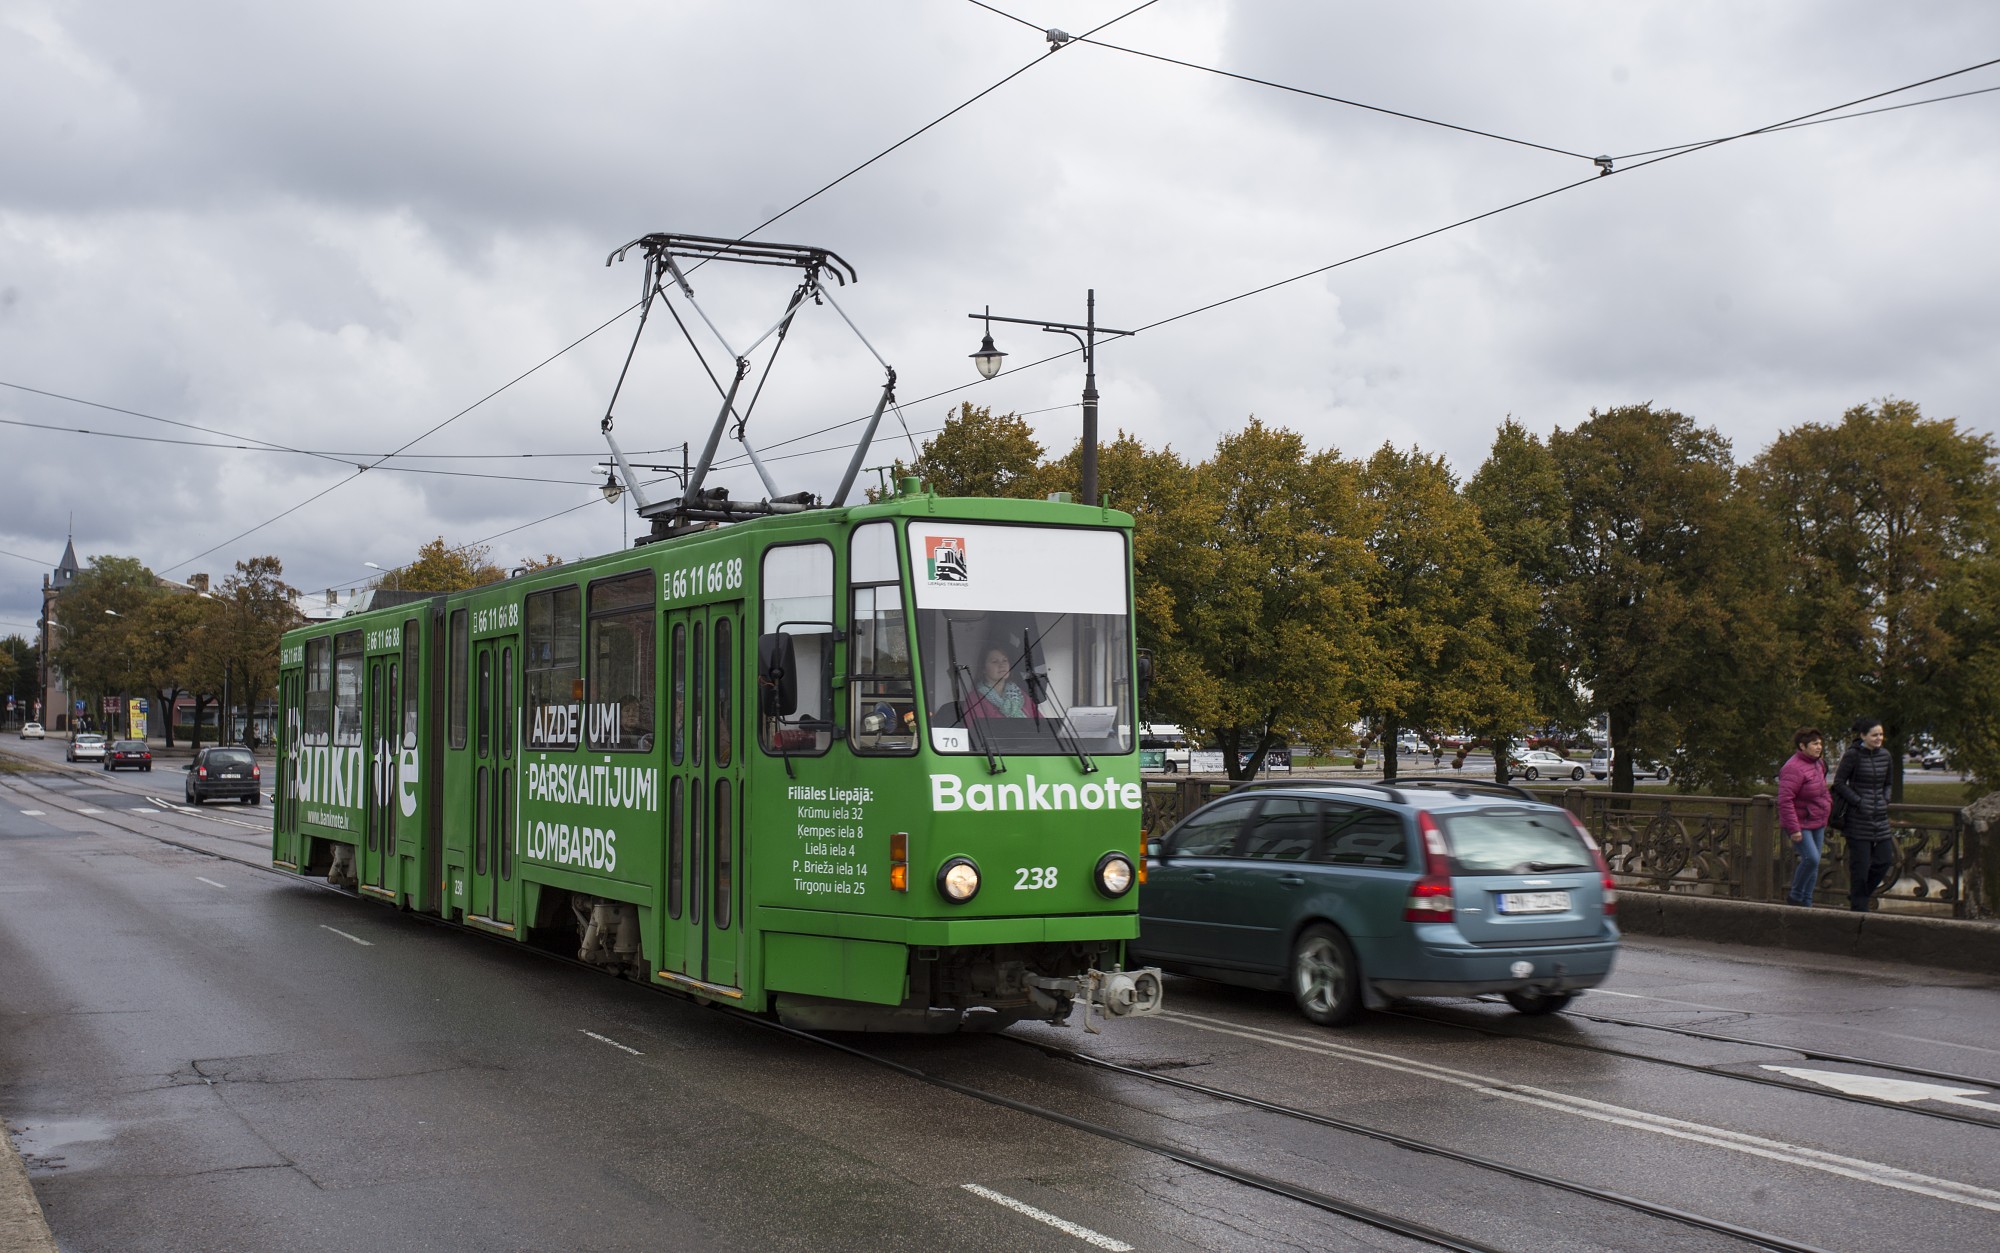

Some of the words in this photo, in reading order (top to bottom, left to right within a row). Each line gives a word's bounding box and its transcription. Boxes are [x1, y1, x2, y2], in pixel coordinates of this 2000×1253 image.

[673, 570, 687, 599] 66
[690, 566, 704, 595] 11
[707, 561, 723, 593] 66
[726, 557, 742, 590] 88
[478, 610, 487, 632] 66
[489, 607, 497, 630] 11
[499, 604, 507, 629] 66
[508, 603, 518, 627] 88
[370, 632, 377, 650] 66
[378, 629, 384, 649] 11
[385, 628, 392, 647] 66
[393, 627, 400, 647] 88
[942, 737, 959, 748] 70
[529, 753, 657, 812] PĀRSKAITĪJUMI
[929, 773, 1142, 812] Banknote
[788, 786, 827, 800] Filiāles
[829, 787, 874, 805] Liepājā:
[307, 808, 350, 830] www.banknote.lv
[798, 806, 830, 819] Krūmu
[832, 807, 850, 820] iela
[851, 807, 864, 820] 32
[797, 824, 836, 841] Ķempes
[838, 825, 856, 839] iela
[857, 826, 864, 839] 8
[527, 820, 617, 872] LOMBARDS
[805, 842, 827, 856] Lielā
[829, 844, 847, 857] iela
[848, 845, 856, 857] 4
[793, 860, 802, 873] P.
[804, 861, 834, 875] Brieža
[836, 862, 854, 876] iela
[855, 864, 868, 876] 14
[1013, 866, 1059, 890] 238
[794, 878, 832, 896] Tirgoņu
[834, 881, 851, 894] iela
[853, 882, 865, 895] 25
